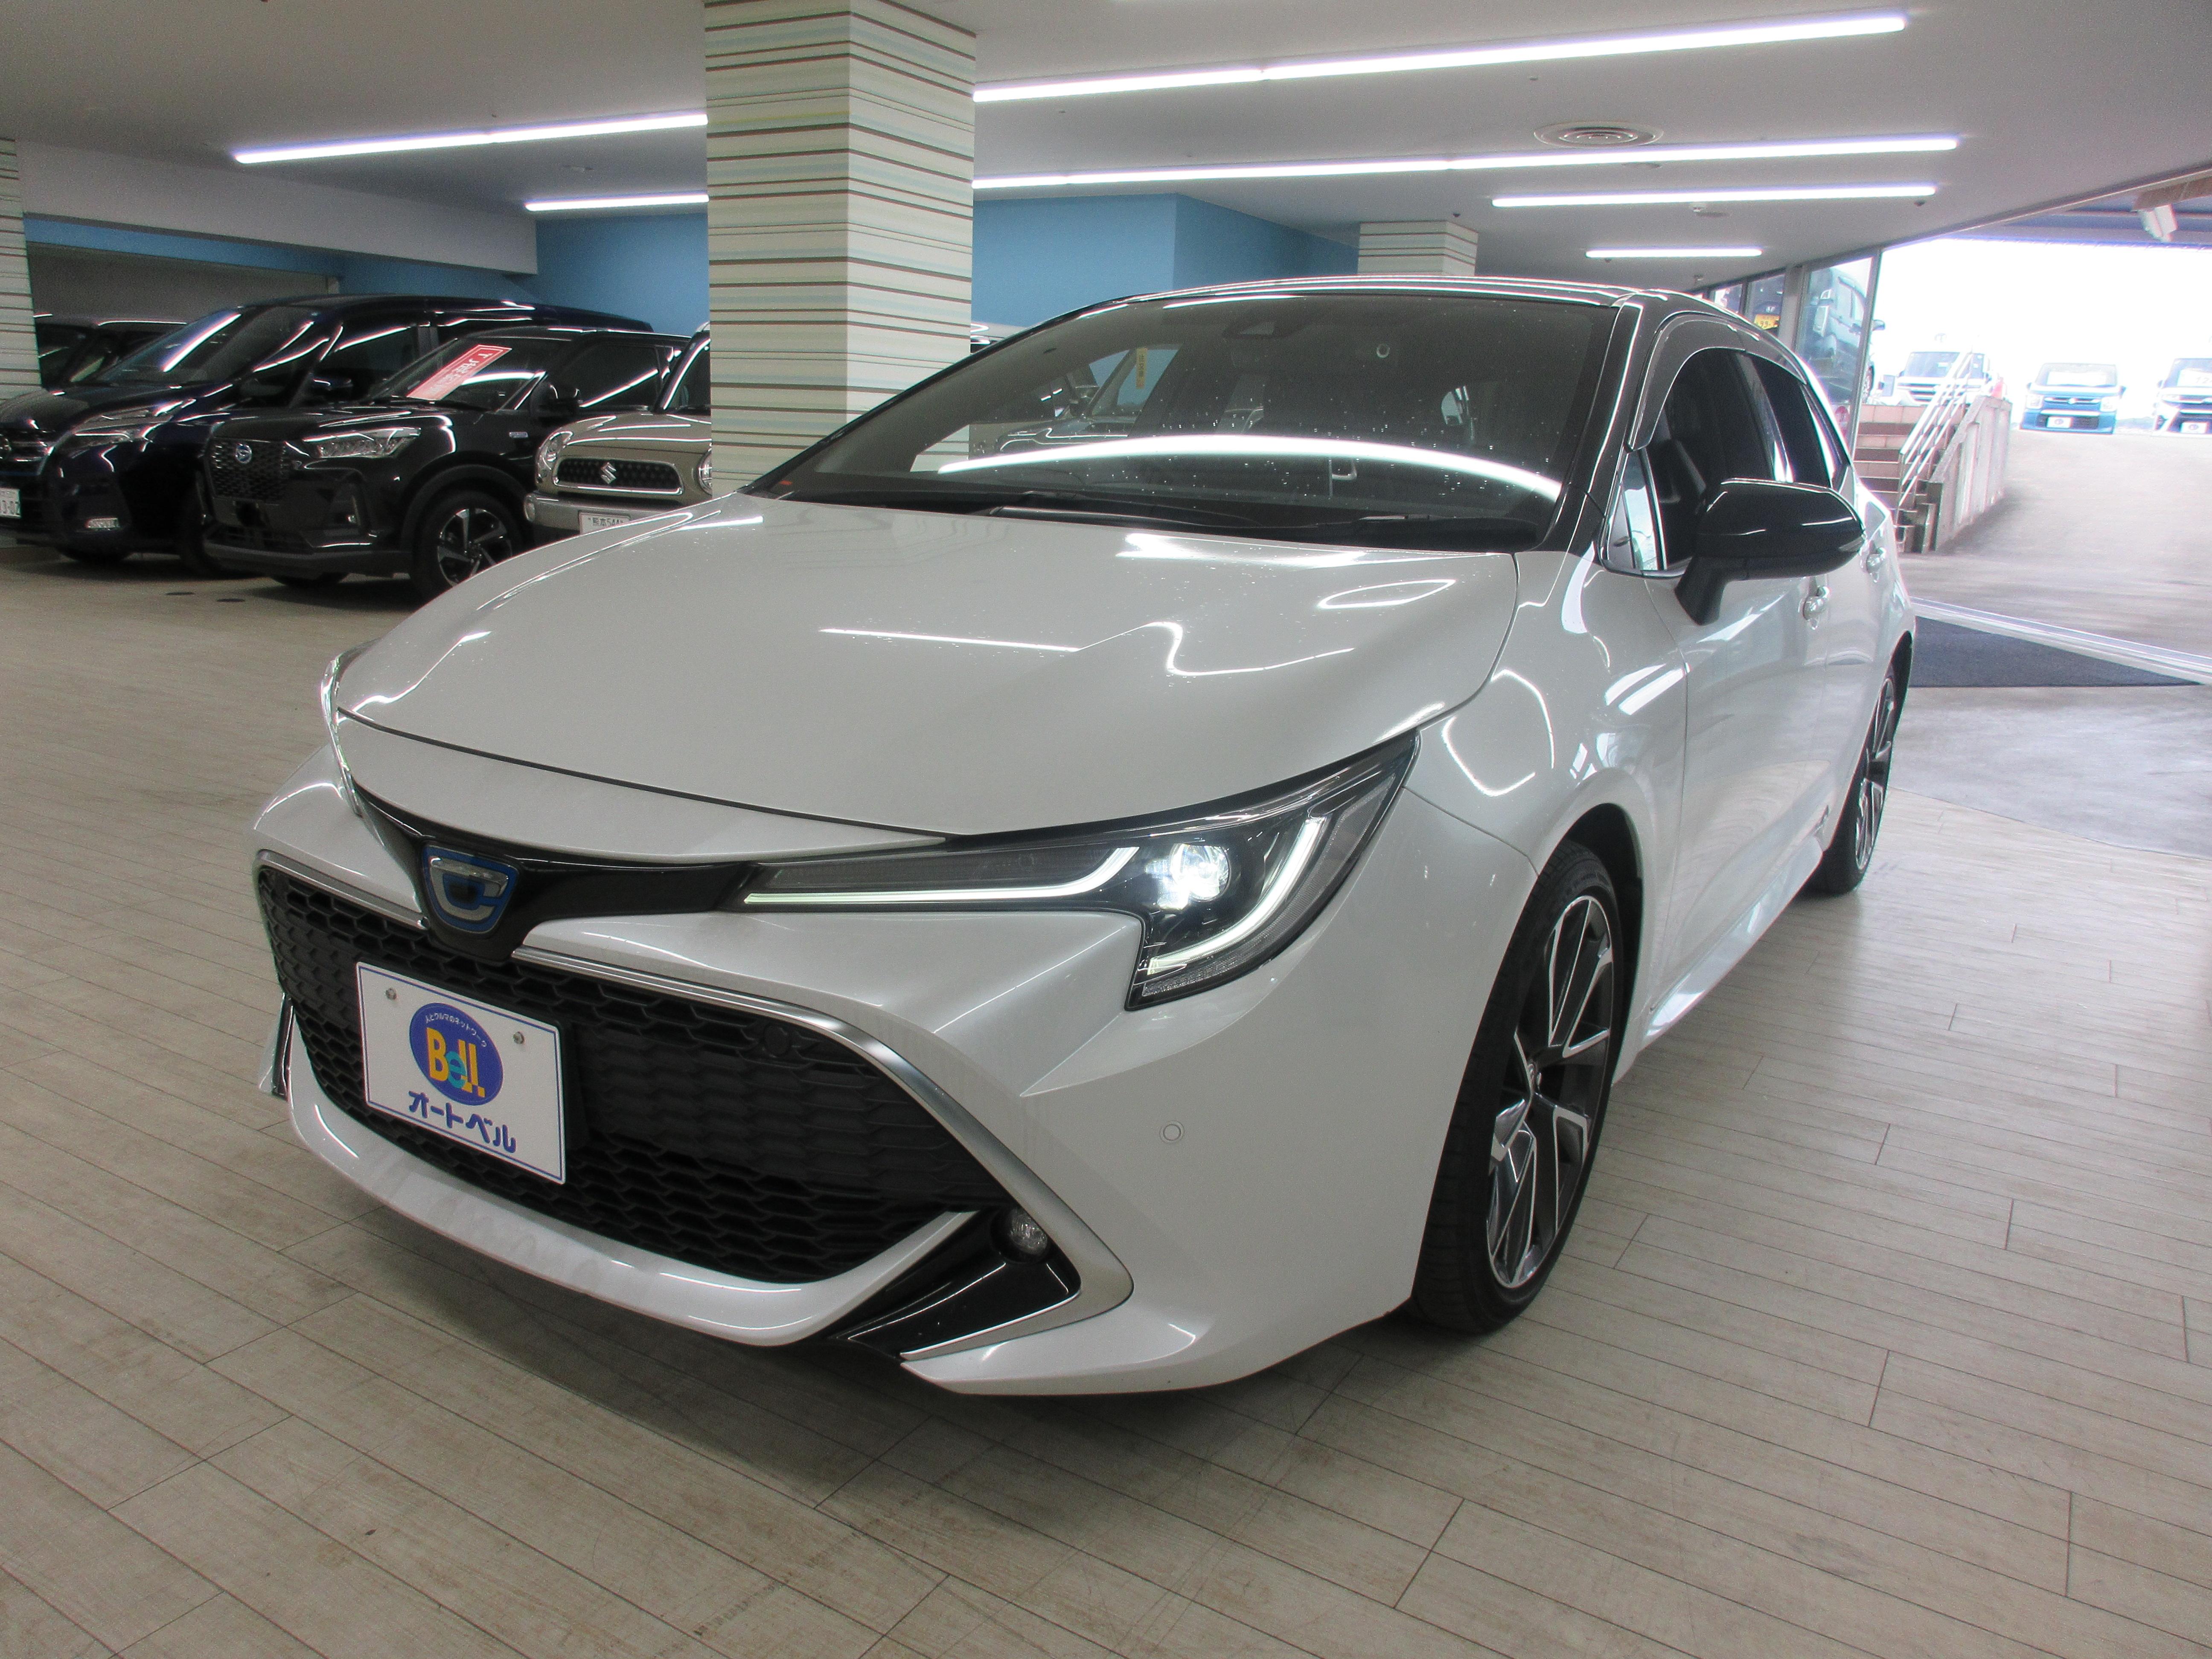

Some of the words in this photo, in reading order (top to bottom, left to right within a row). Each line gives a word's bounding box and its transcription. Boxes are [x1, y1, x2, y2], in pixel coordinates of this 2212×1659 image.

[409, 1091, 517, 1153] オートベル
